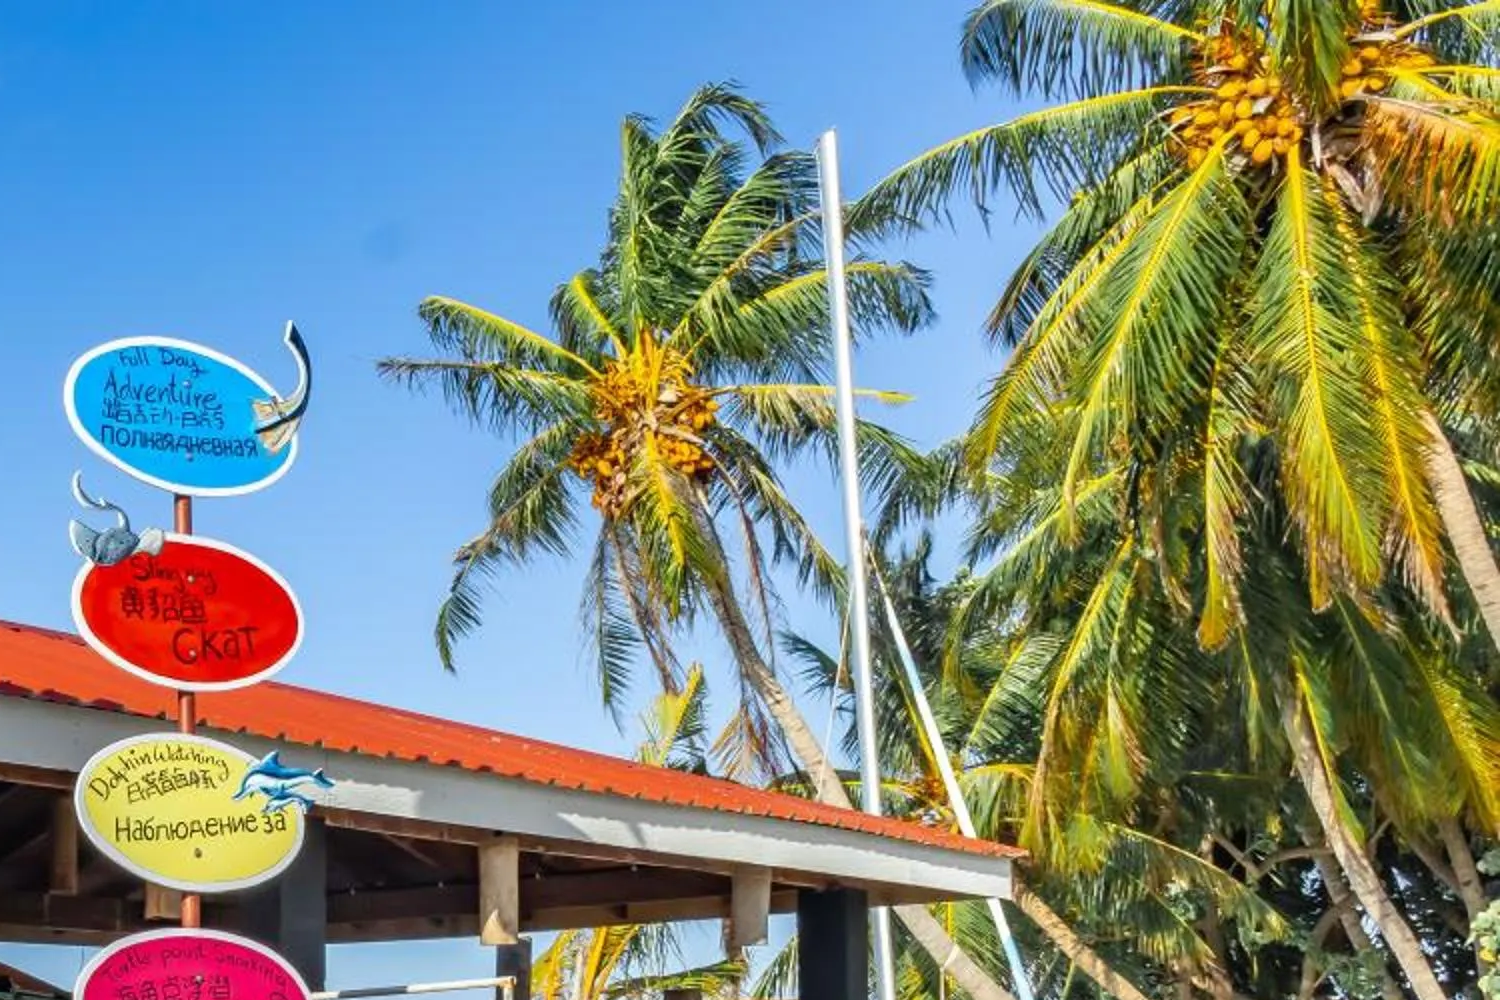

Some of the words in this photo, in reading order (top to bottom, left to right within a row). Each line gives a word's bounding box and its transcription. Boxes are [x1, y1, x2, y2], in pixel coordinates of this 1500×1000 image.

[119, 348, 150, 367] Full
[160, 348, 206, 377] Day
[104, 369, 222, 411] Adventure
[172, 626, 259, 665] Скат
